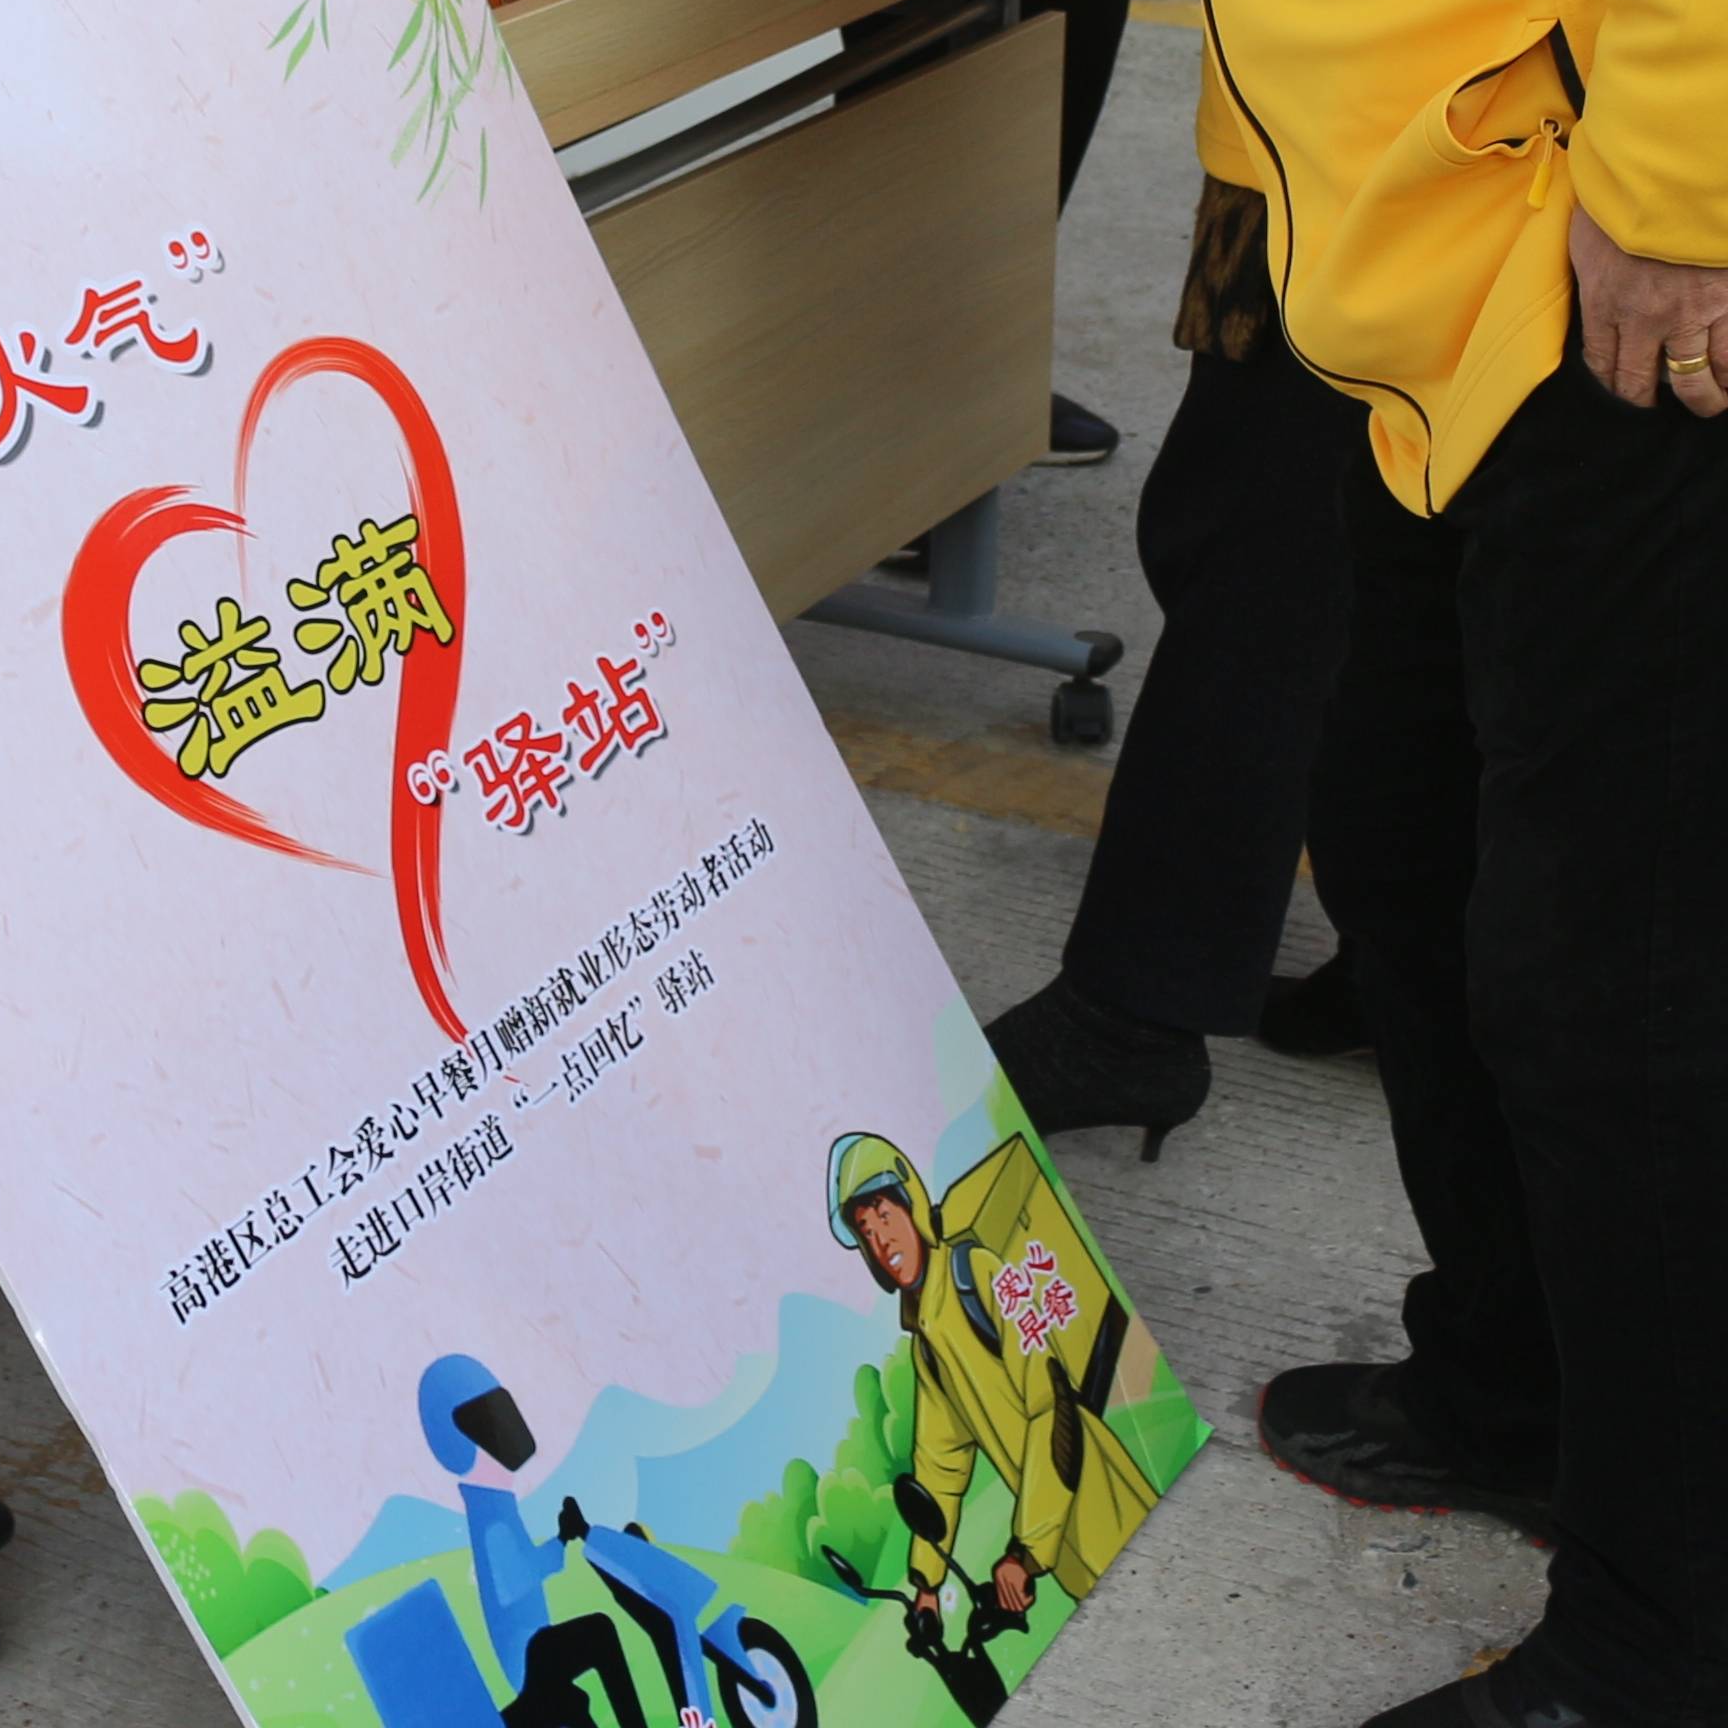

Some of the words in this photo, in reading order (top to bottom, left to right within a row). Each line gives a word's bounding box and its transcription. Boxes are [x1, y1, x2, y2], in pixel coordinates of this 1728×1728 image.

[139, 515, 456, 780] 溢满
[160, 817, 776, 1324] 高港区总工会爱心早餐月赠新就业形态劳动者活动
[994, 1242, 1055, 1316] 爱心
[1016, 1278, 1077, 1351] 早餐
